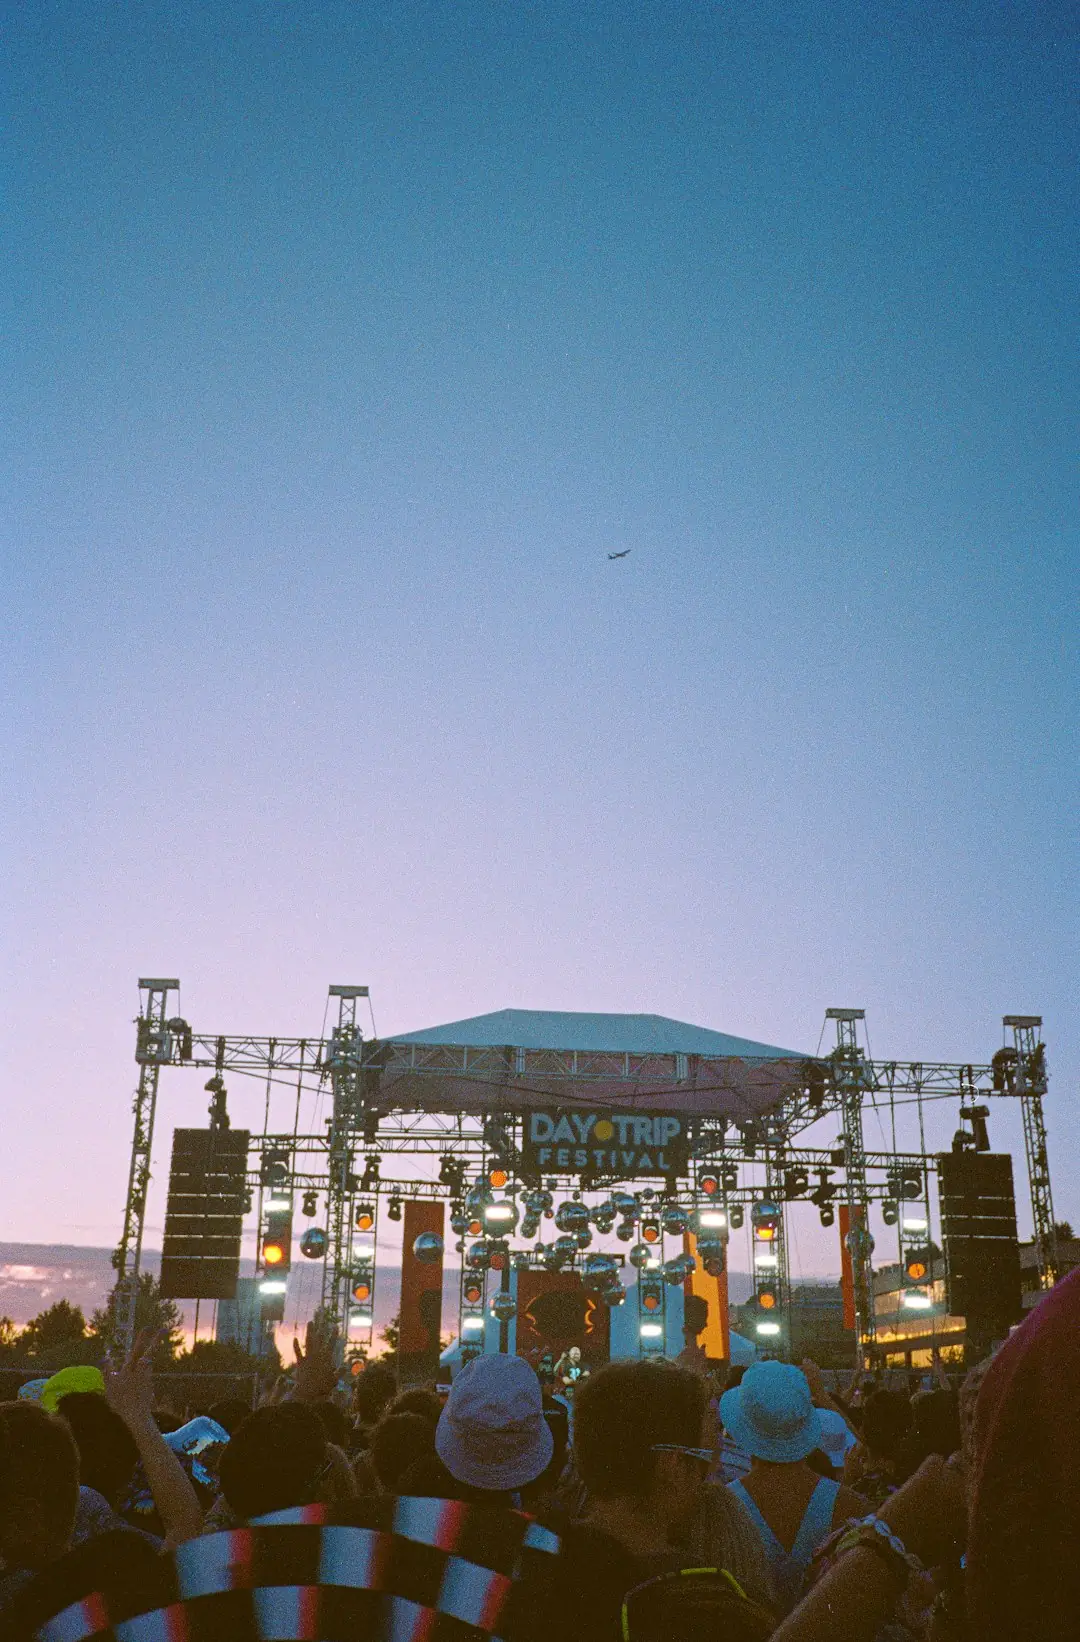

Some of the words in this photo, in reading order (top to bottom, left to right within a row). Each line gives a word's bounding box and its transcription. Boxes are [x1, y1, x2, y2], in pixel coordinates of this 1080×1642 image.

[530, 1112, 597, 1144] DAY
[611, 1114, 681, 1146] TRIP
[539, 1147, 670, 1170] FESTIVAL
